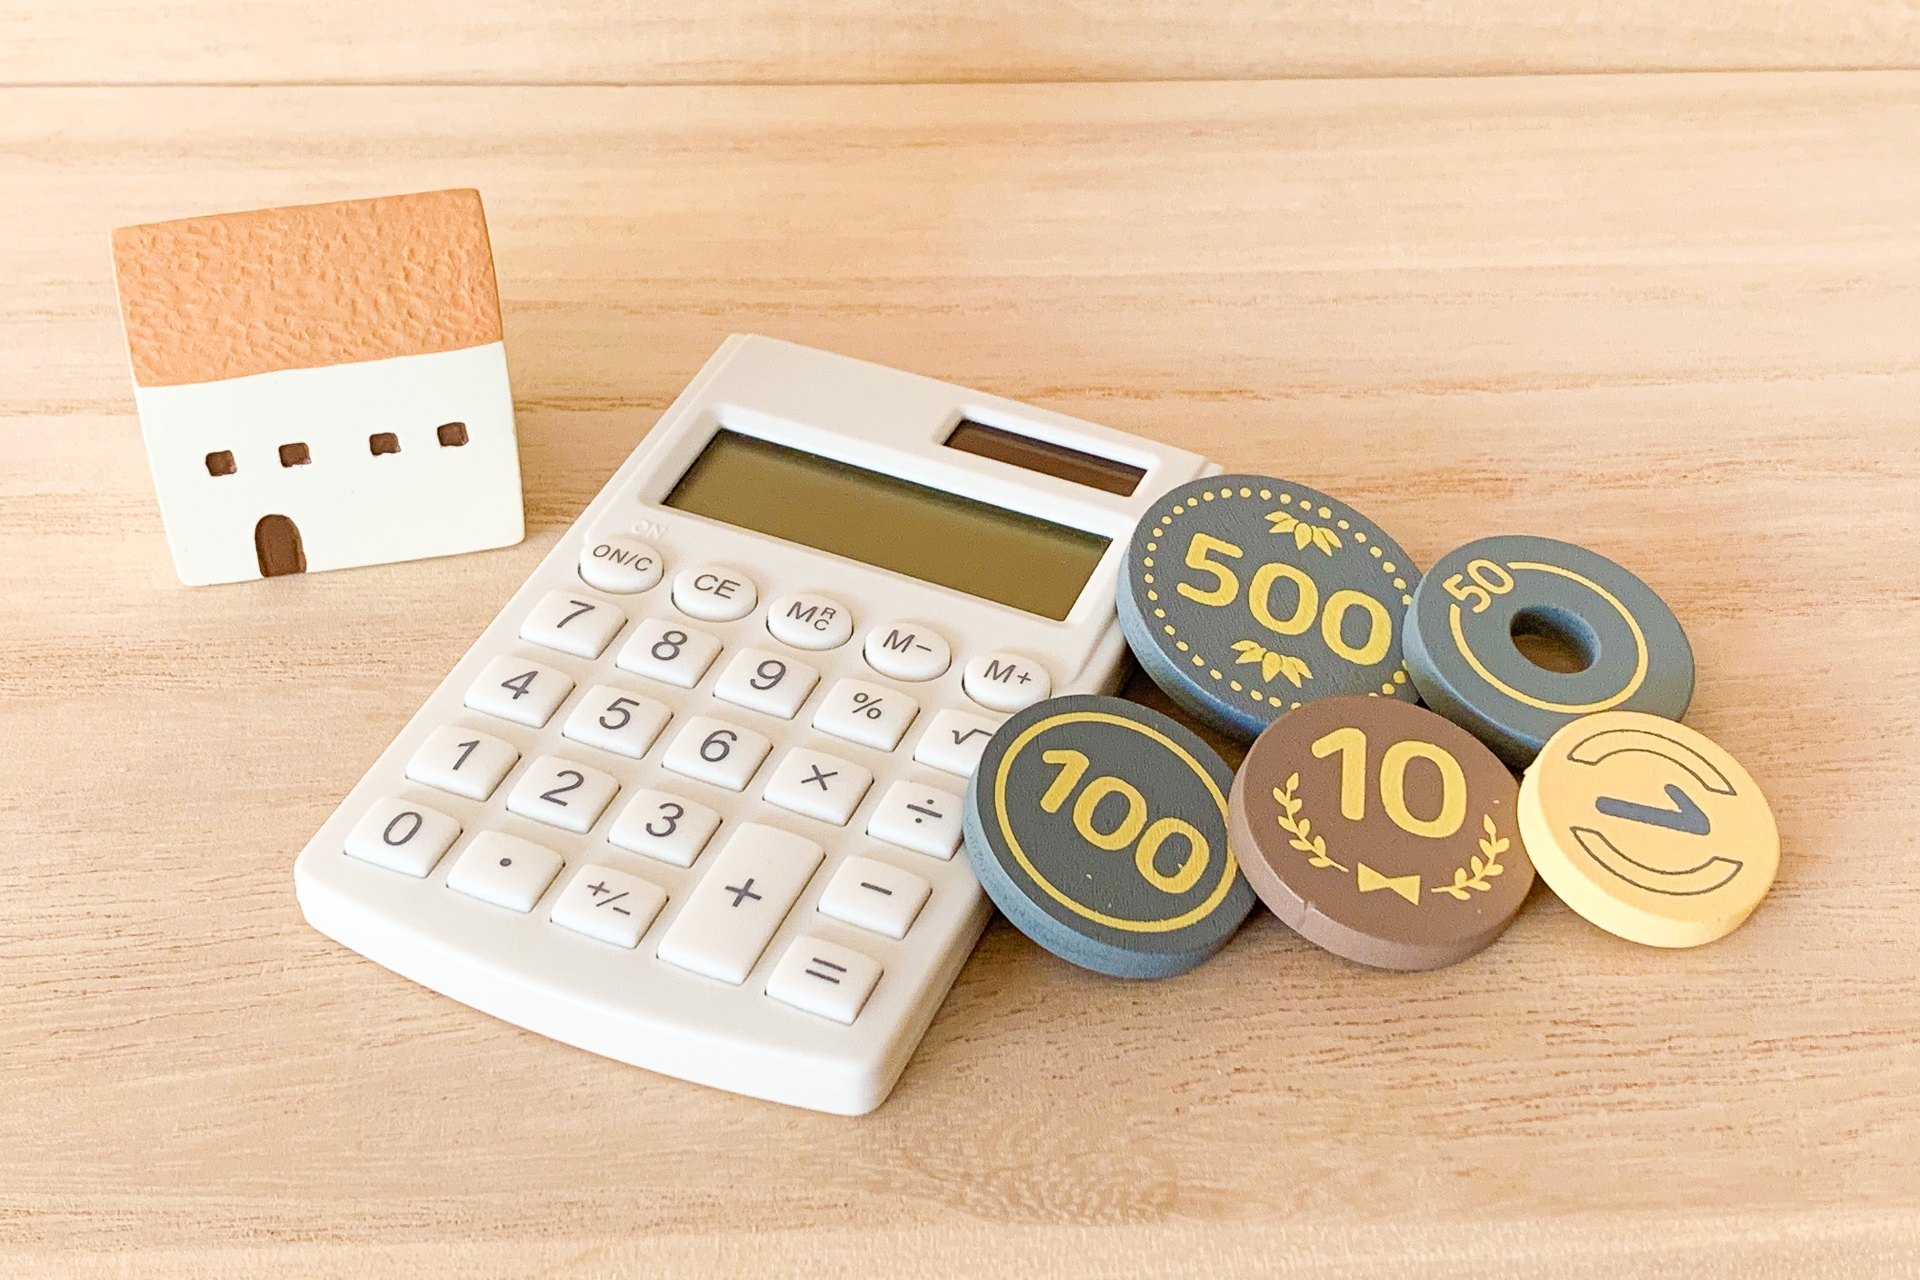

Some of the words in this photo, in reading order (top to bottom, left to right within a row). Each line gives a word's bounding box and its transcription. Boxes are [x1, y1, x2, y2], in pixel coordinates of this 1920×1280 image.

[631, 520, 668, 540] ON
[592, 544, 653, 572] ON/C
[693, 574, 741, 600] CE
[1176, 532, 1393, 666] 500
[1441, 558, 1515, 614] 50
[556, 600, 596, 629] 7
[651, 630, 688, 661] 8
[501, 670, 539, 700] 4
[749, 659, 787, 691] 9
[983, 659, 1032, 685] M+
[599, 697, 641, 730] 5
[851, 692, 883, 720] %
[452, 739, 481, 771] 1
[699, 729, 738, 763] 6
[539, 770, 585, 807] 2
[1311, 727, 1468, 839] 10
[645, 802, 685, 838] 3
[1039, 749, 1210, 894] 100
[1595, 783, 1711, 836] 1
[383, 811, 423, 846] 0
